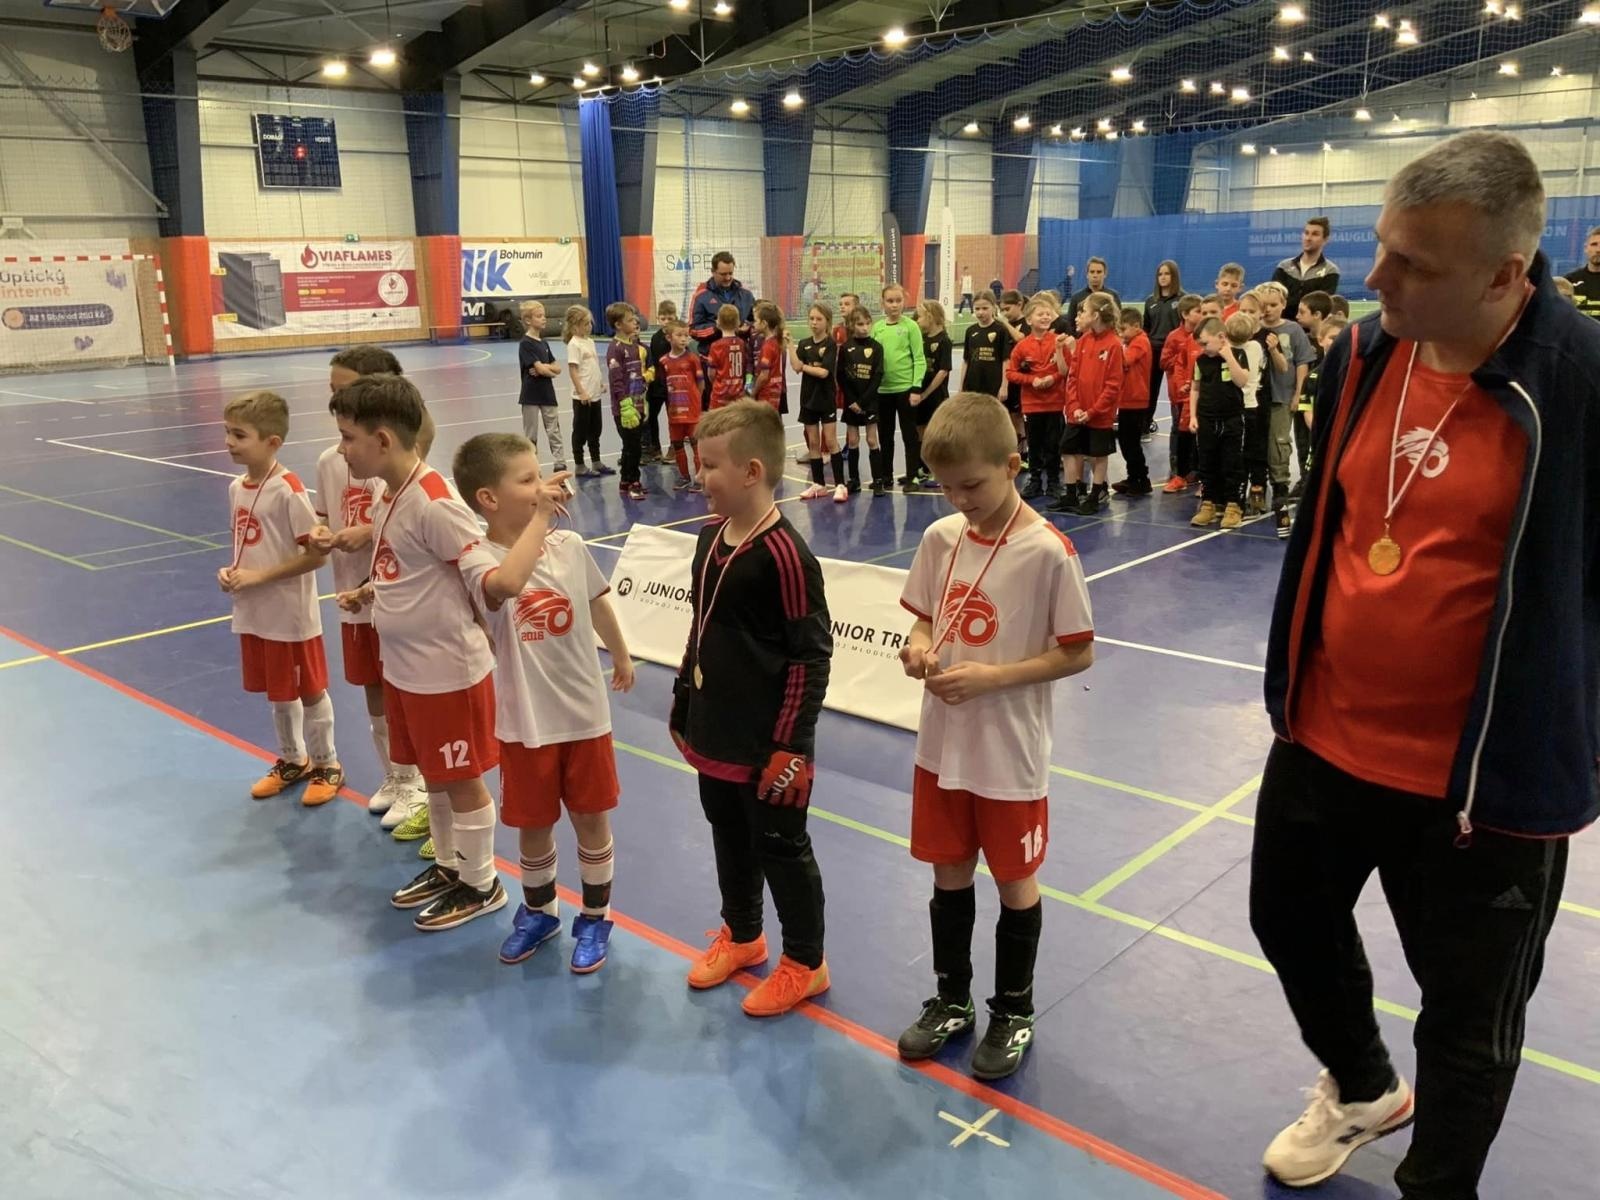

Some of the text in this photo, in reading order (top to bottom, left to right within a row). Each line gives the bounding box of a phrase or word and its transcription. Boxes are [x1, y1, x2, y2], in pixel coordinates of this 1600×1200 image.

[319, 249, 393, 261] VIAFLAMES
[1, 285, 70, 298] internet
[643, 581, 692, 603] JUNIOR
[439, 740, 470, 769] 12
